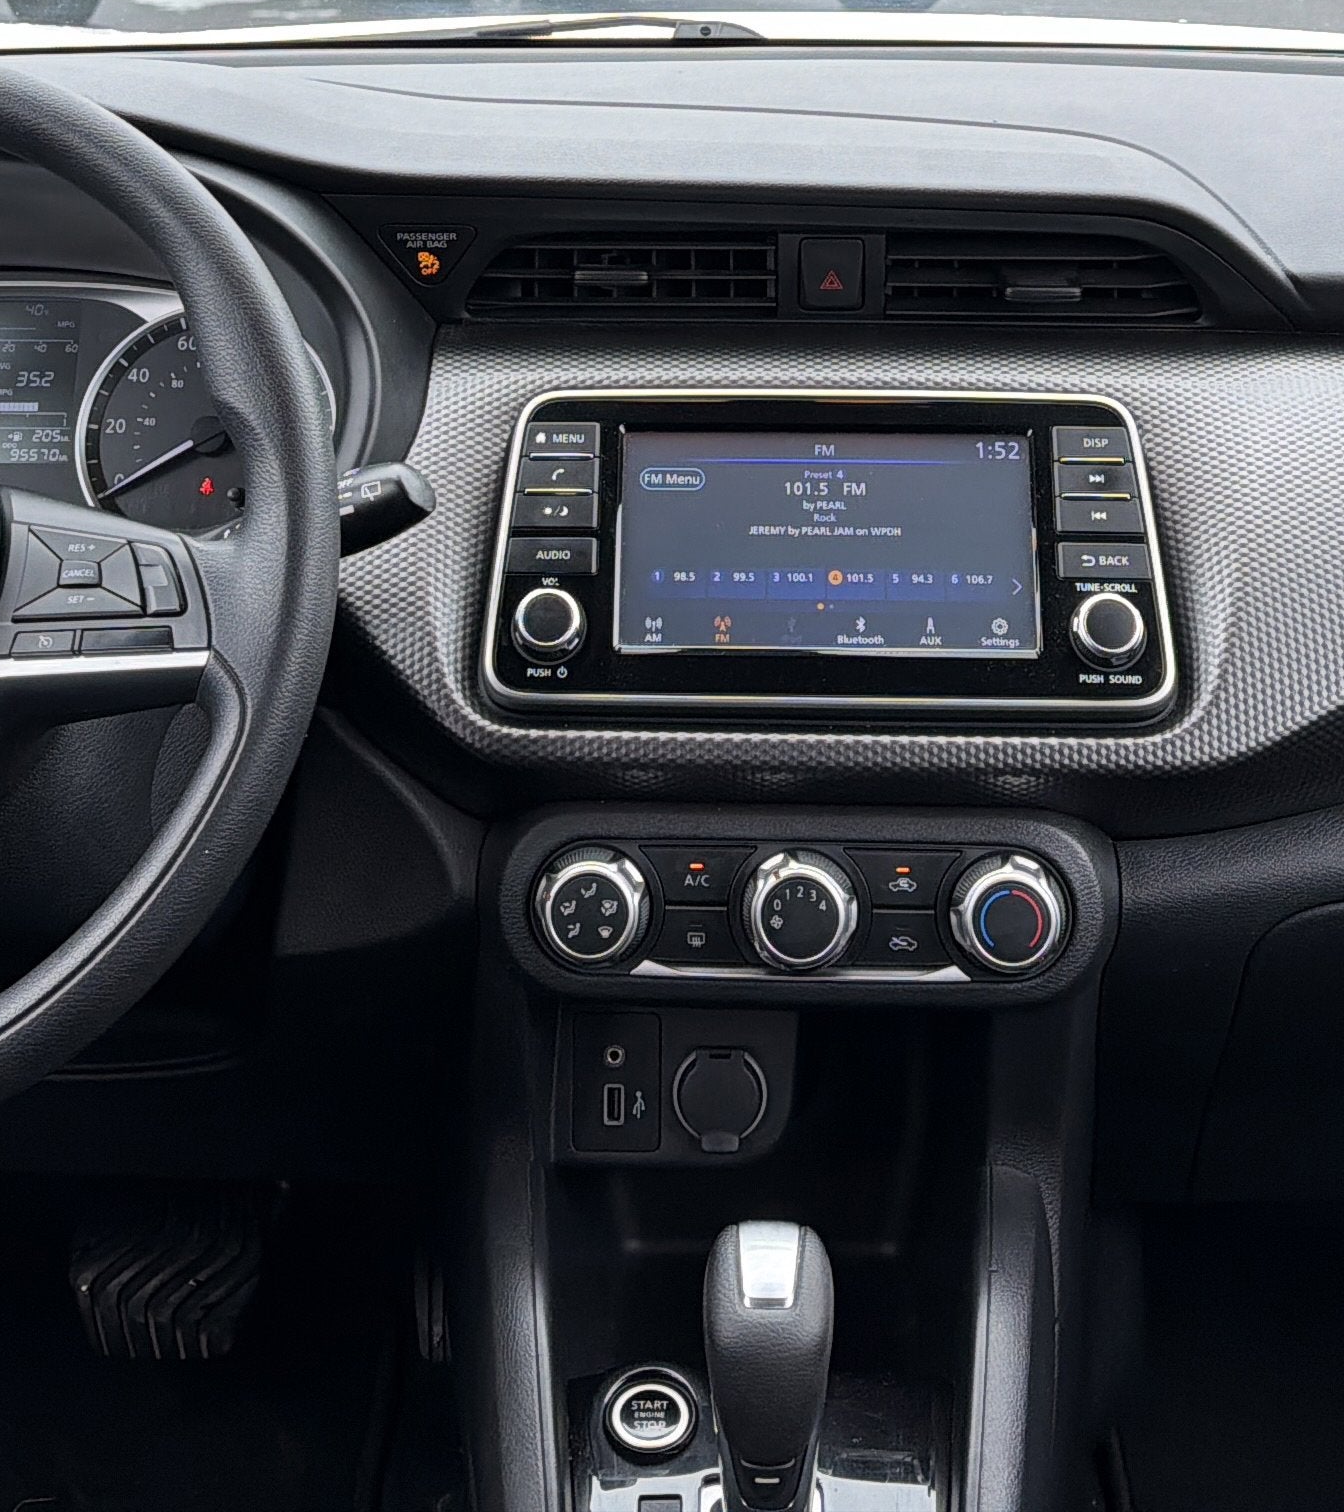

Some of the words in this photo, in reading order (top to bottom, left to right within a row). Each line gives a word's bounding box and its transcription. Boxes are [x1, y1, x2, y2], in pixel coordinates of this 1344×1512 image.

[397, 232, 457, 241] PASSENGER
[1, 344, 15, 352] 20
[34, 344, 47, 352] 40
[65, 344, 78, 353] 60
[127, 368, 149, 383] 40
[171, 380, 184, 388] 80
[105, 418, 126, 433] 20
[143, 417, 156, 426] 40
[32, 430, 61, 442] 205
[552, 433, 585, 444] MENU
[1083, 438, 1109, 448] DISP
[10, 448, 60, 461] 95570
[814, 444, 835, 456] FM
[975, 441, 1020, 460] 1:52
[644, 474, 662, 484] FM
[665, 473, 700, 485] Menu
[804, 470, 832, 479] Preset
[836, 470, 844, 479] 4
[784, 482, 828, 495] 101.5
[843, 482, 866, 496] FM
[802, 500, 815, 512] by
[817, 501, 847, 510] PEARL
[814, 514, 837, 522] Rock
[748, 526, 786, 535] JEREMY
[787, 525, 800, 537] by
[801, 526, 831, 535] PEARL
[833, 527, 853, 536] JAM
[856, 528, 868, 536] on
[871, 527, 902, 536] WPDH
[68, 544, 86, 552] RES
[536, 550, 571, 560] AUDIO
[1098, 556, 1130, 566] BACK
[62, 567, 96, 579] CANCEL
[654, 571, 660, 580] 1
[673, 572, 696, 581] 98.5
[713, 572, 721, 581] 2
[733, 572, 755, 582] 99.5
[773, 572, 780, 582] 3
[787, 572, 813, 582] 100.1
[846, 573, 874, 583] 101.5
[892, 573, 899, 583] 5
[911, 574, 933, 584] 94.3
[951, 574, 958, 584] 6
[966, 575, 993, 584] 106.7
[67, 595, 84, 604] SET
[644, 633, 662, 642] AM
[715, 634, 730, 643] FM
[837, 635, 884, 645] Bluetooth
[919, 637, 942, 646] AUX
[980, 636, 1019, 648] Settings
[527, 667, 552, 678] PUSH
[1079, 674, 1104, 684] PUSH
[1109, 674, 1143, 685] SOUND
[684, 874, 710, 887] A/C
[785, 889, 790, 900] 1
[796, 886, 804, 898] 2
[809, 889, 817, 901] 3
[773, 899, 781, 911] 0
[818, 900, 827, 912] 4
[631, 1400, 669, 1410] START
[634, 1411, 665, 1419] ENGINE
[634, 1420, 666, 1430] STOP
